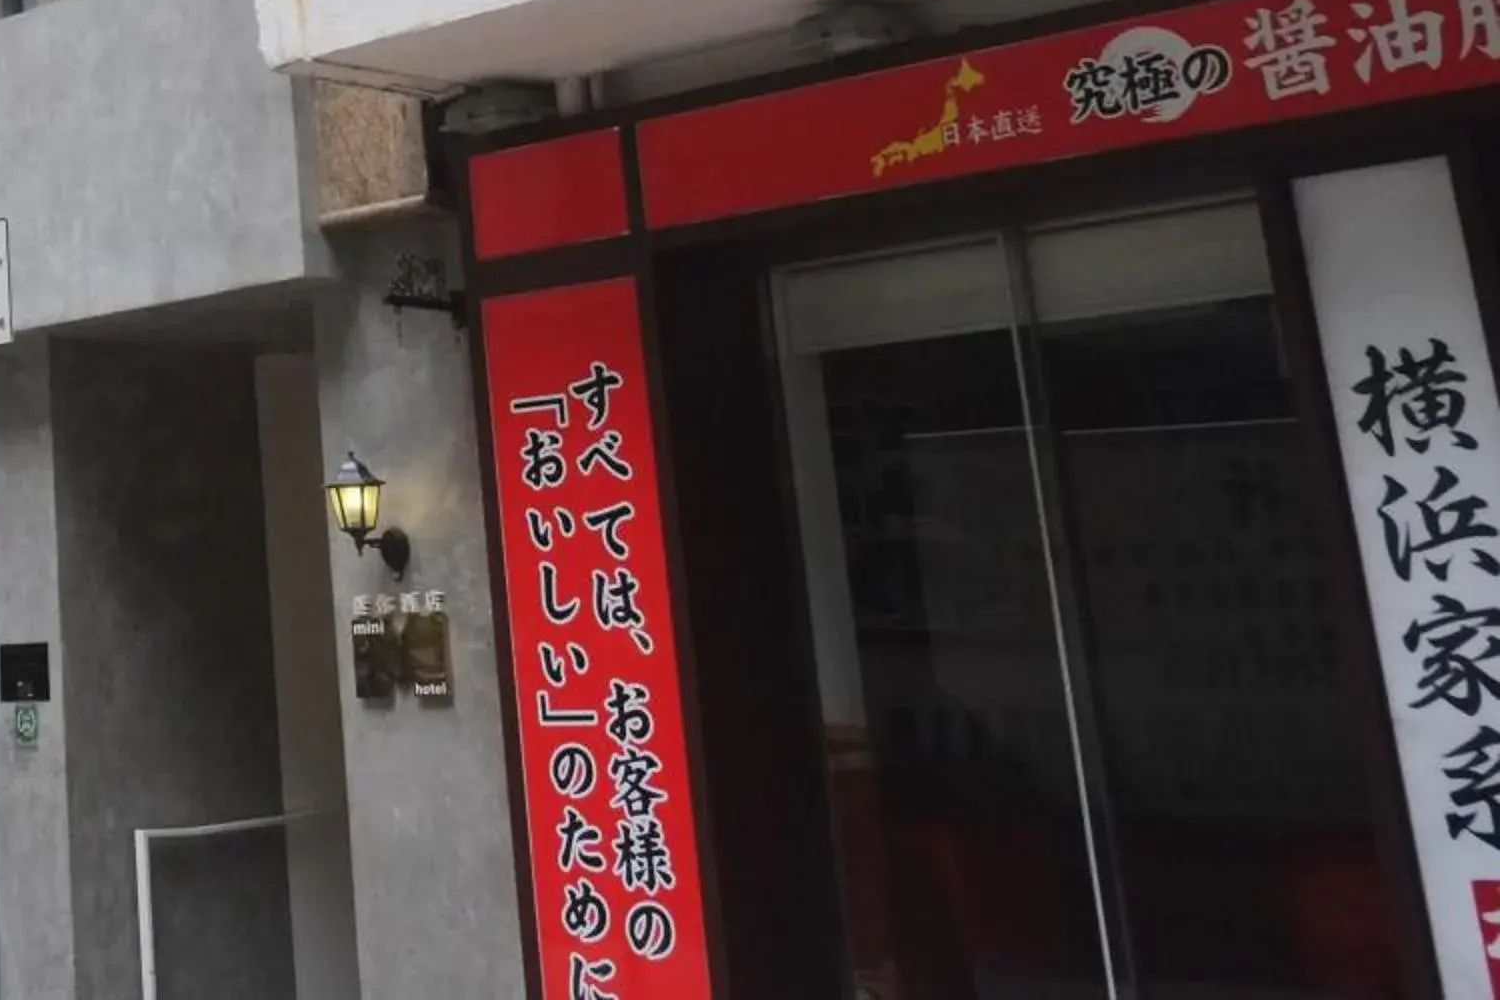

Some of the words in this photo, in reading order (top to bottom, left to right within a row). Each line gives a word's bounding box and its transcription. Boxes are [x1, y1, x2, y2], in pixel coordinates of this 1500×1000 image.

[941, 104, 1044, 148] 日本直送
[353, 620, 385, 636] mini
[568, 361, 677, 959] すべては、お客様の
[414, 681, 448, 696] hotel
